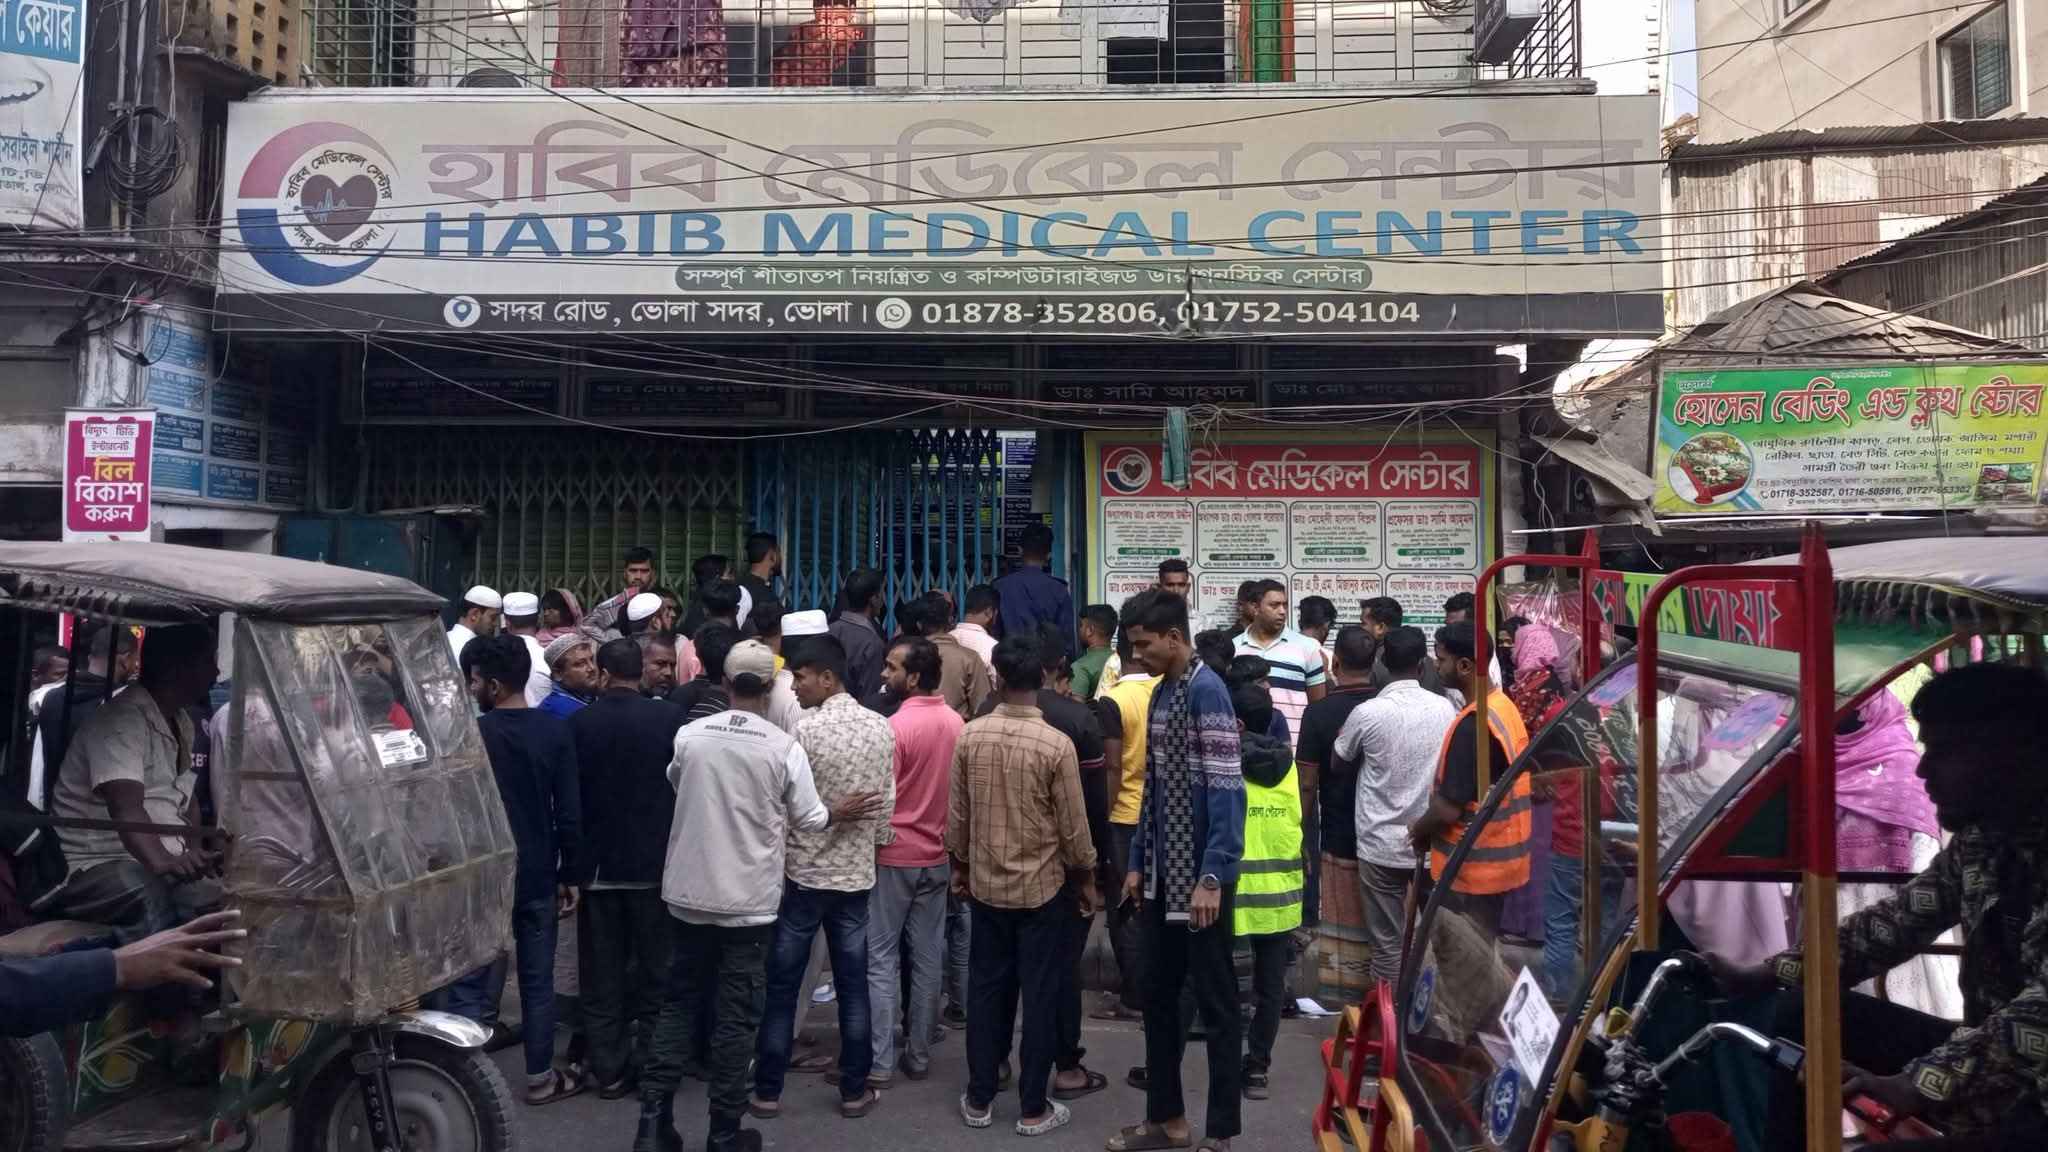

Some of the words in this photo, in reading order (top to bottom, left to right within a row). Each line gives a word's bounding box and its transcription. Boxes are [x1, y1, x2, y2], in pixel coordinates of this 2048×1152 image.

[16, 1, 76, 51] কেয়ার
[286, 166, 311, 199] হাবিব
[311, 149, 367, 171] মেডিকেল
[367, 164, 393, 200] সেন্টার
[422, 120, 727, 208] হাবিব
[761, 119, 1243, 206] মেডিকেল
[1281, 121, 1642, 201] সেন্টার
[424, 211, 726, 257] HABIB
[763, 211, 1215, 257] MEDICAL
[1248, 209, 1644, 257] CENTER
[683, 265, 746, 289] সম্পূর্ণ
[752, 266, 845, 286] শীতাতপ
[851, 265, 933, 286] নিয়ন্ত্রিত
[939, 269, 958, 286] ও
[1291, 264, 1365, 286] সেন্টার
[489, 300, 547, 323] সদর
[553, 299, 621, 327] রোড,
[631, 299, 698, 323] ভোলা
[706, 299, 775, 327] সদর,
[784, 301, 853, 324] ভোলা
[921, 301, 1166, 328] 01878-352806,
[1176, 301, 1420, 325] 01752-504104
[1055, 386, 1096, 399] ডাঃ
[1103, 382, 1155, 399] সামি
[1673, 391, 1767, 428] হোসেন
[1771, 376, 1852, 427] বেডিং
[1909, 385, 1965, 431] ক্লথ
[93, 456, 136, 482] বিল
[1247, 447, 1370, 493] মেডিকেল
[1380, 450, 1472, 491] সেন্টার
[74, 475, 145, 503] বিকাশ
[84, 505, 135, 523] করুন
[728, 714, 748, 727] BP
